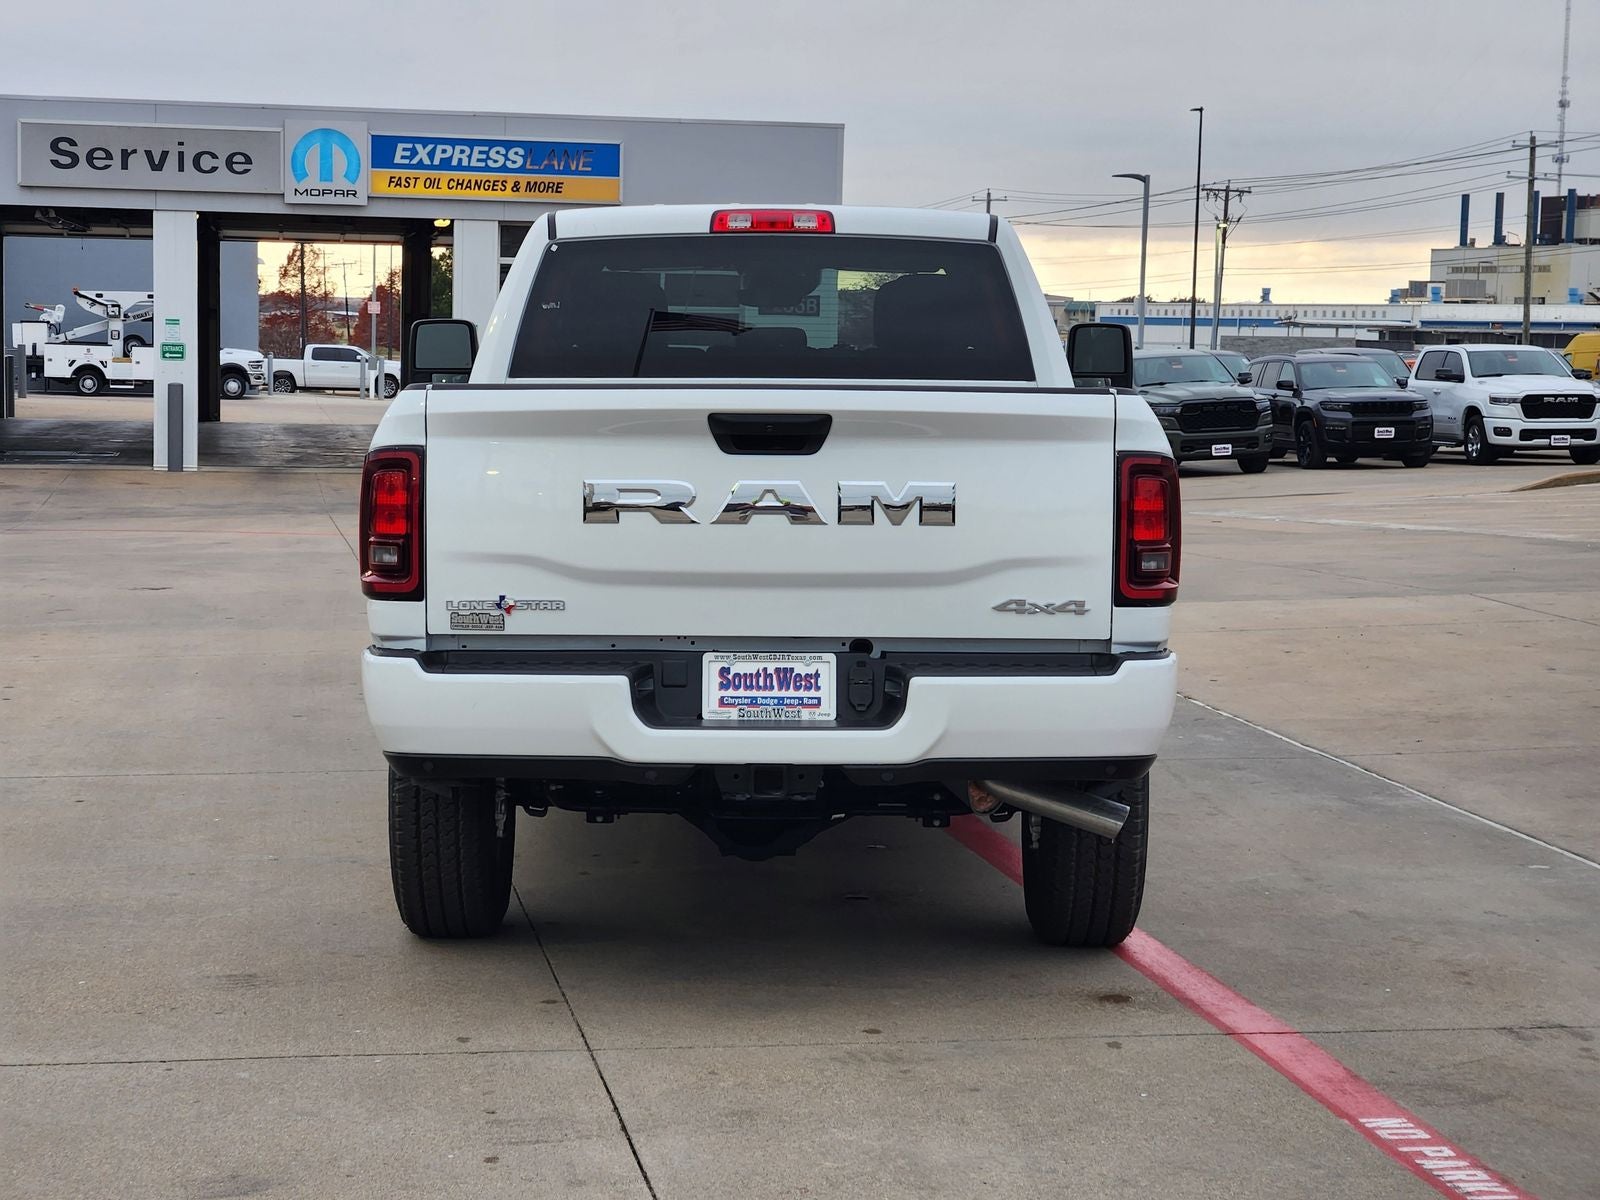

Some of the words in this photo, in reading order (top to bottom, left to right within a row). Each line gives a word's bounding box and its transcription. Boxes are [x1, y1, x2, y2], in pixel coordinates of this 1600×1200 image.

[49, 136, 254, 175] Service
[294, 187, 359, 199] MOPAR
[387, 176, 420, 189] FAST
[423, 177, 443, 190] OIL
[446, 178, 507, 192] CHANGES
[511, 181, 521, 193] &
[524, 181, 564, 194] MORE
[582, 479, 957, 526] RAM
[446, 600, 498, 611] LONE
[515, 600, 566, 611] STAR
[991, 599, 1091, 615] 4x4
[451, 612, 504, 624] SouthWest
[718, 666, 821, 692] SouthWest
[723, 697, 751, 705] Chrysler
[757, 697, 778, 705] Dodge
[783, 697, 800, 705] Jeep
[738, 708, 802, 719] SouthWest
[1358, 1117, 1431, 1140] NO
